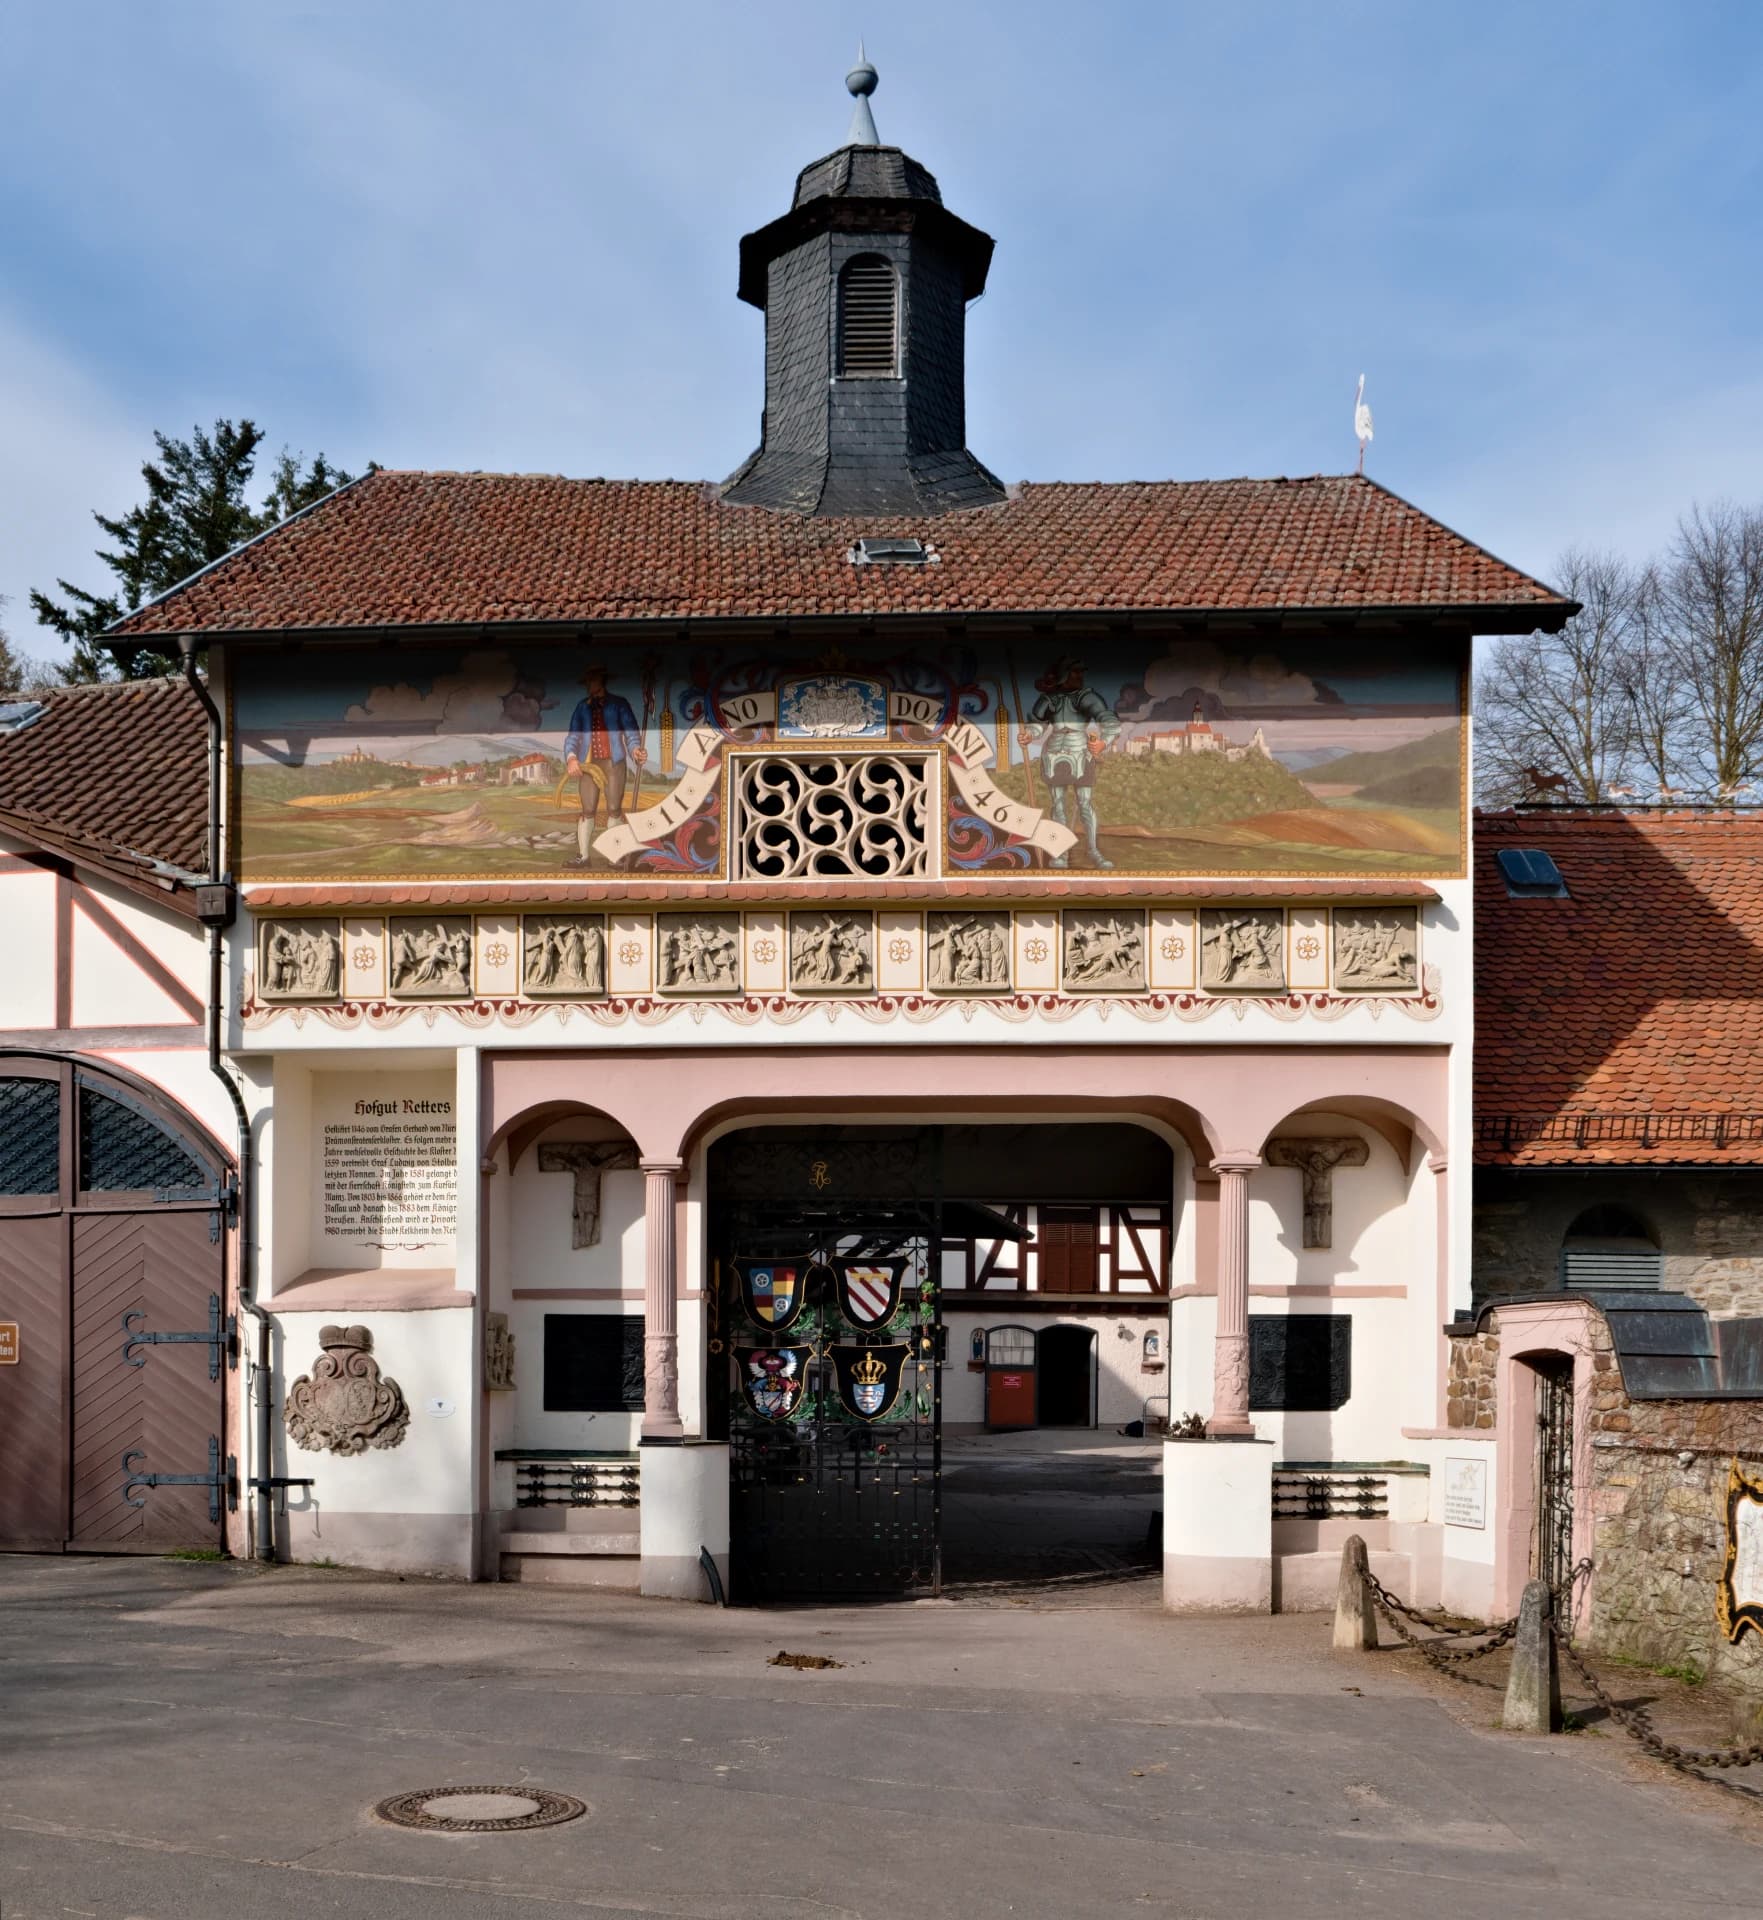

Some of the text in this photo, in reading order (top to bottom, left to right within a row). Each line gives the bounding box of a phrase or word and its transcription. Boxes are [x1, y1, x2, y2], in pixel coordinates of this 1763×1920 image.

[973, 790, 1013, 823] 46
[354, 1099, 451, 1117] Hofgut Retters
[403, 1124, 428, 1132] Gerhard
[414, 1135, 433, 1145] folgen
[390, 1158, 414, 1168] Ludwig
